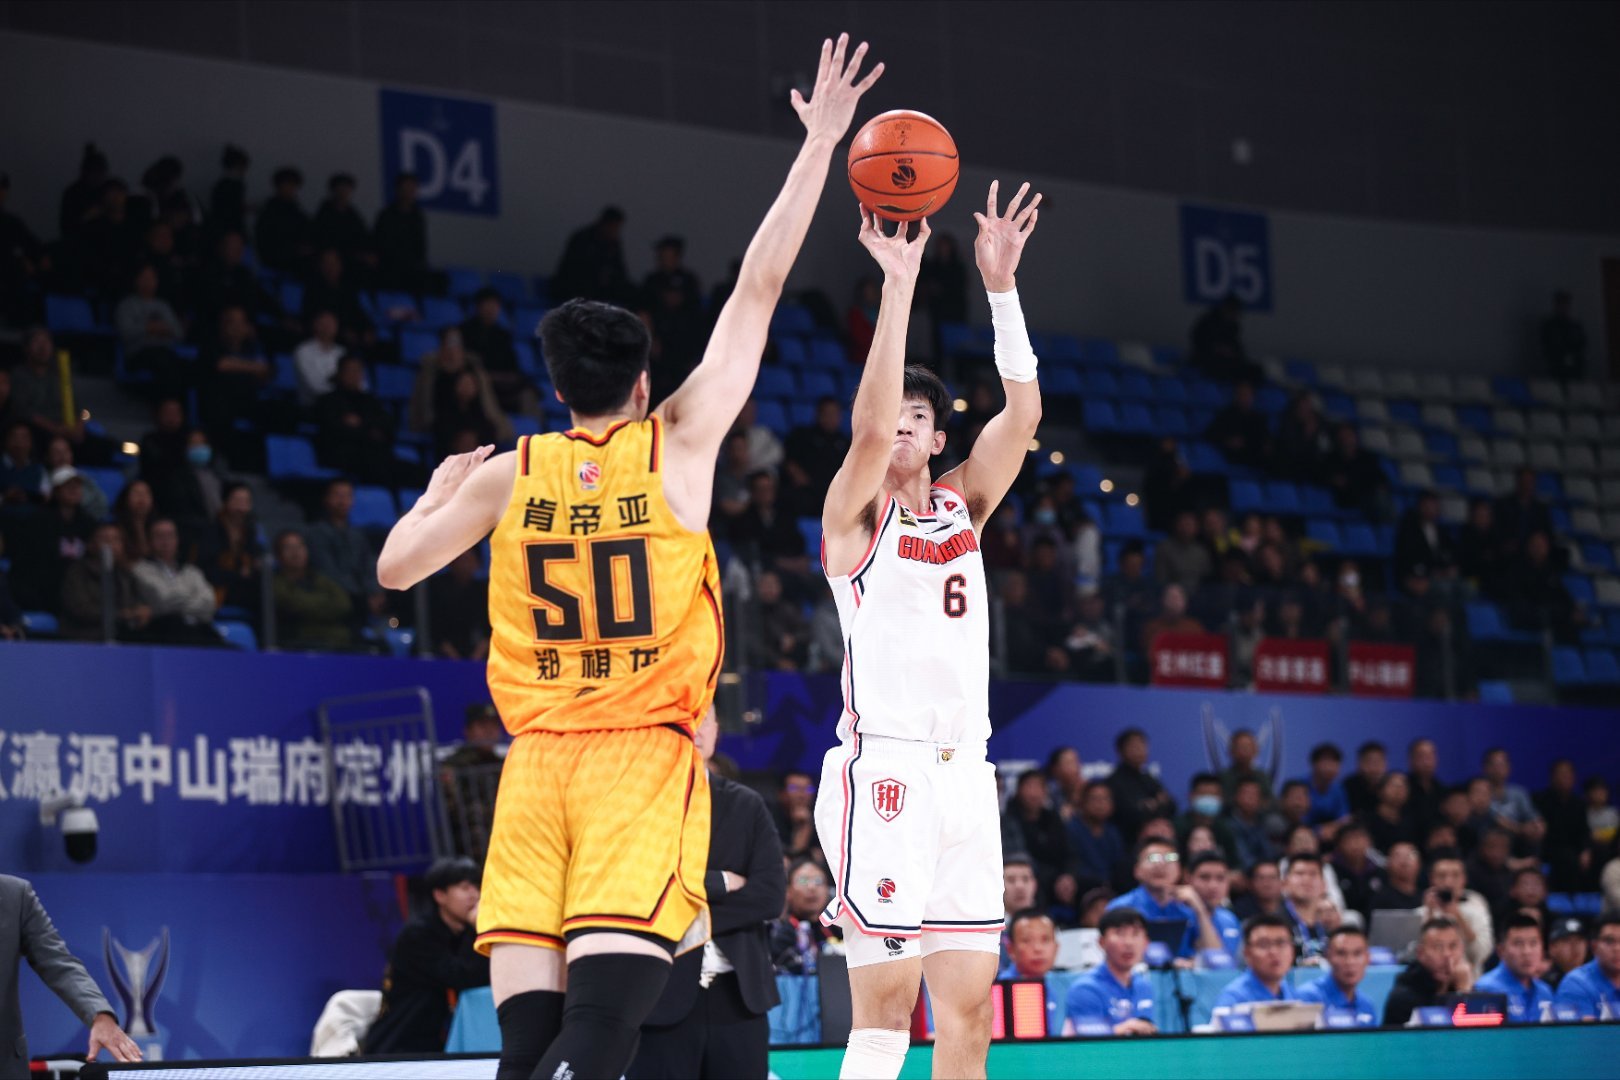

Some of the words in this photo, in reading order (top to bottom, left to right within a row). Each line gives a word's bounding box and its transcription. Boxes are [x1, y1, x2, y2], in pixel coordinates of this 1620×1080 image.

[398, 126, 490, 207] D4
[1194, 236, 1265, 305] D5
[523, 493, 650, 535] 肯帝亚
[898, 529, 979, 565] GUANGDO
[522, 535, 657, 644] 50
[943, 573, 967, 618] 6
